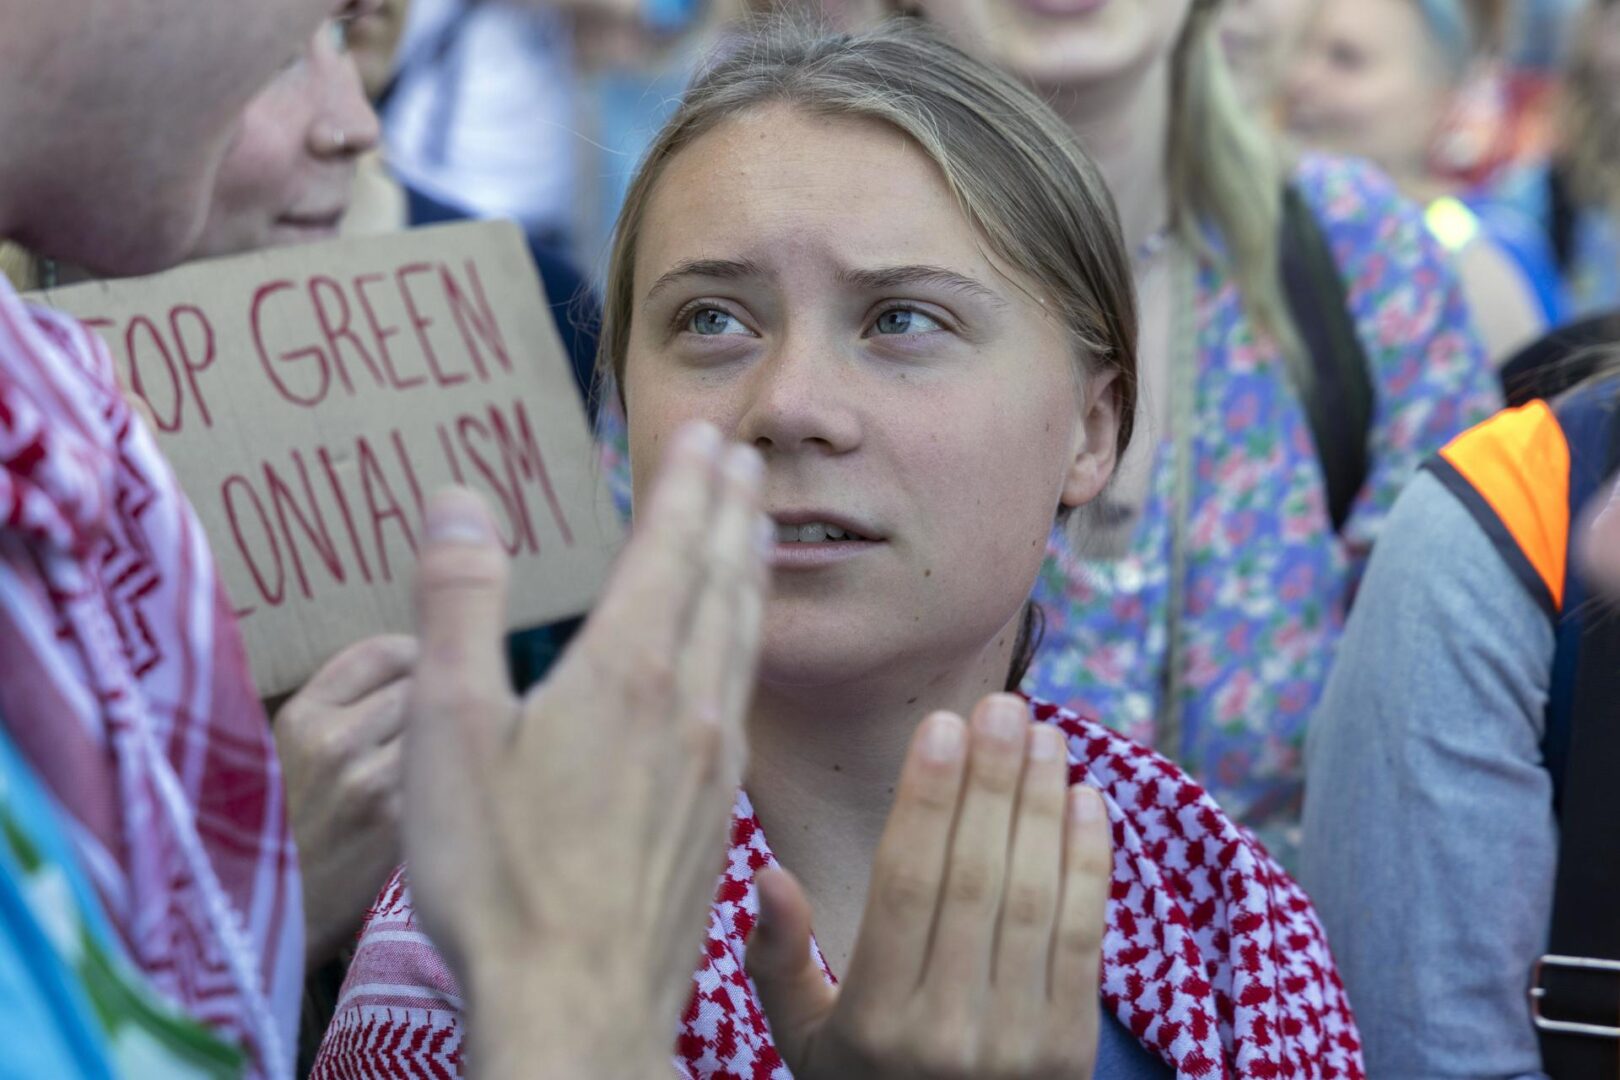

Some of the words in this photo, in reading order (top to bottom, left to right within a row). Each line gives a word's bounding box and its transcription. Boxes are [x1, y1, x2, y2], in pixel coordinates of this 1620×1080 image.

[79, 304, 216, 433] OP
[249, 258, 513, 407] GREEN
[221, 398, 574, 619] ONIASM
